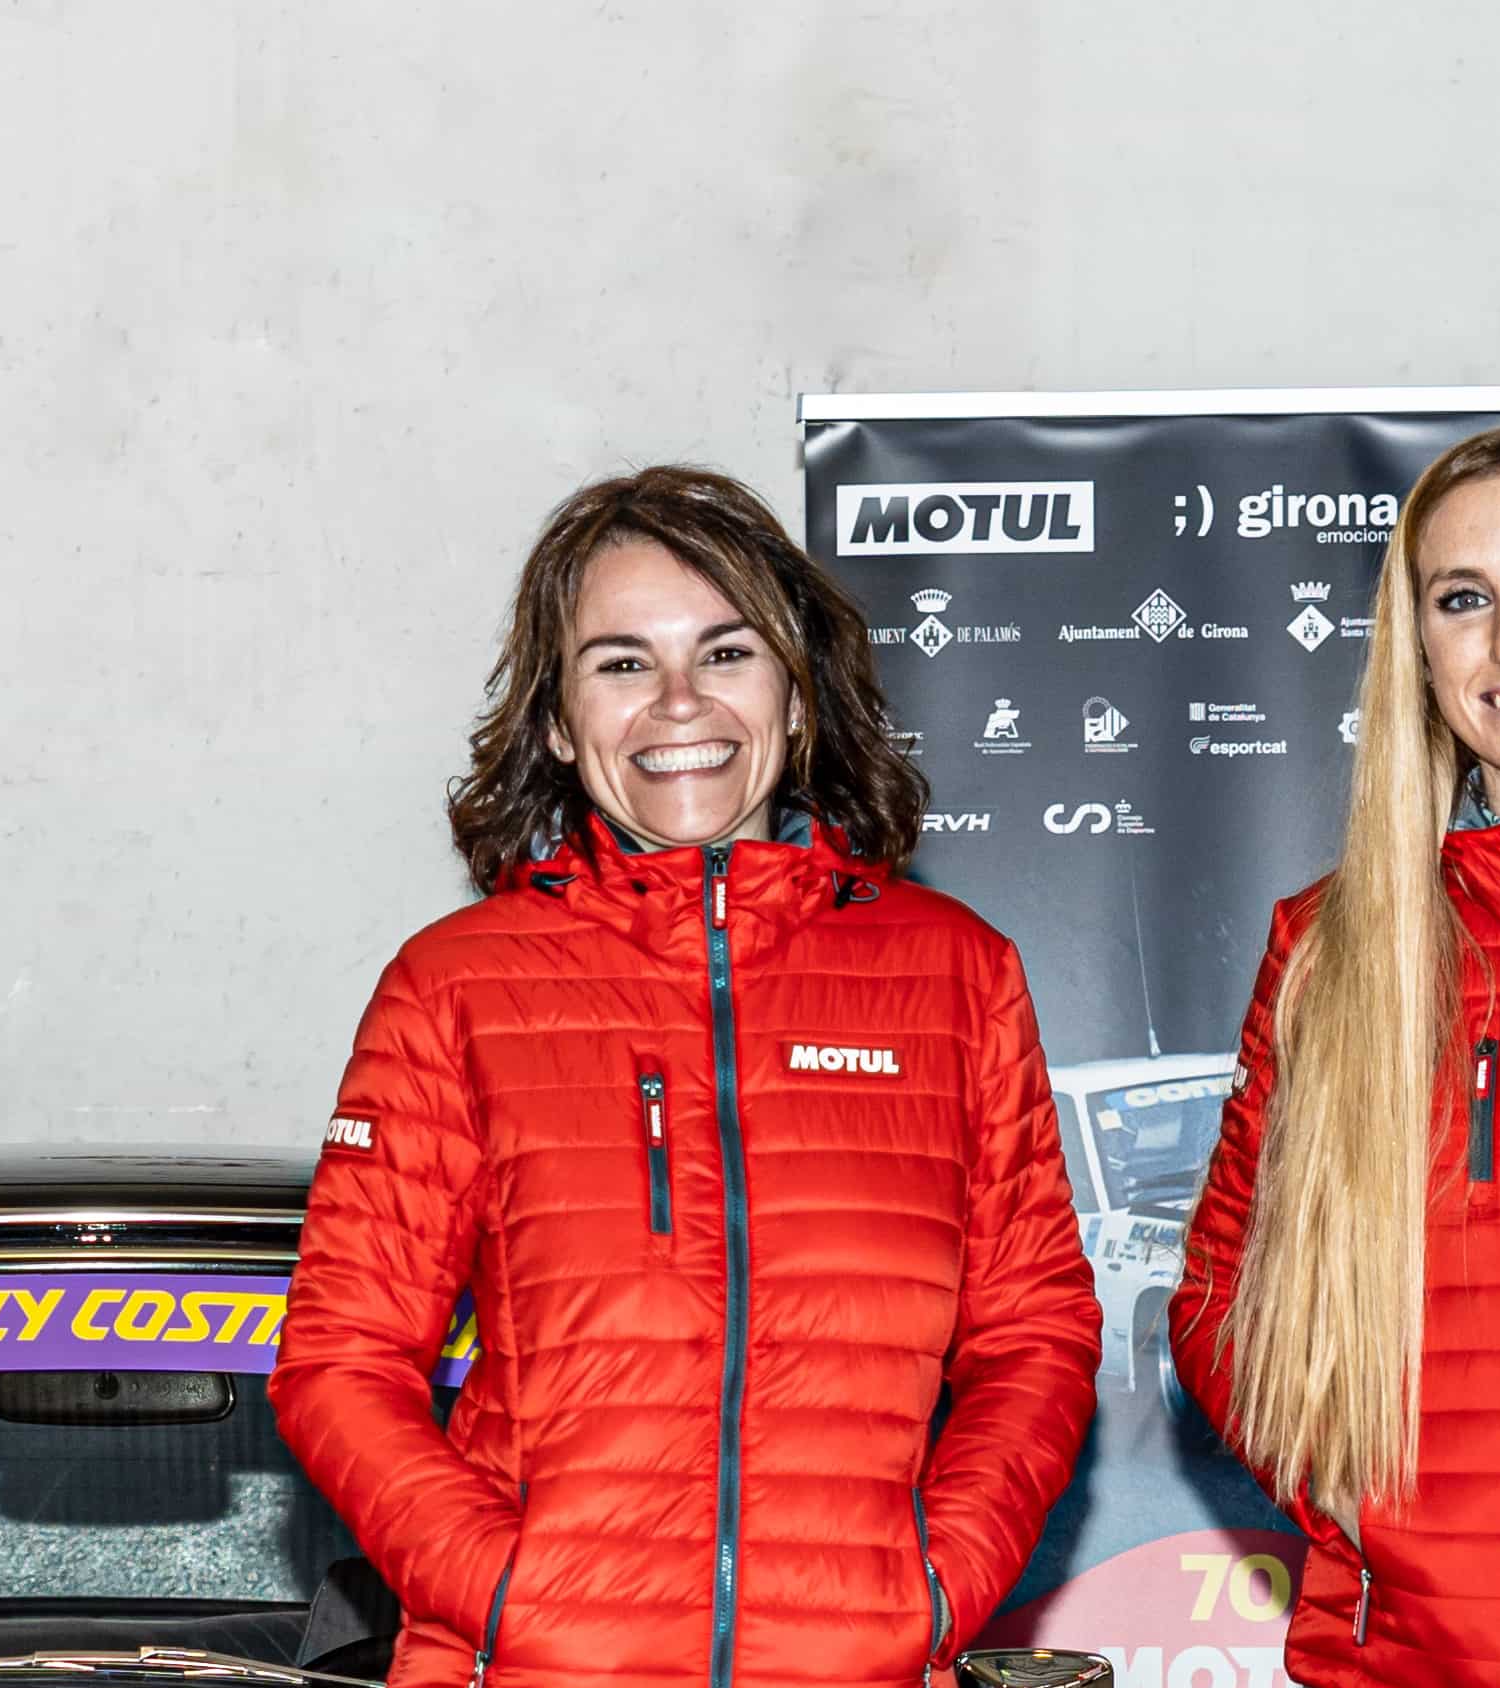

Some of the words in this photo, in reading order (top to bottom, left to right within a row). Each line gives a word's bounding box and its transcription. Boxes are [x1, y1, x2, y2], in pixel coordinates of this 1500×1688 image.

[850, 493, 1081, 545] MOTUL
[1237, 484, 1398, 538] girona
[957, 626, 971, 643] DE
[1058, 624, 1141, 643] Ajuntament
[1178, 623, 1194, 640] de
[1201, 622, 1249, 640] Girona
[1208, 703, 1257, 713] Generalitat
[1208, 712, 1220, 722] de
[1221, 712, 1267, 724] Catalunya
[1209, 739, 1288, 758] esportcat
[789, 1043, 900, 1074] MOTUL
[327, 1118, 373, 1148] OTUL
[1180, 1554, 1292, 1622] 70
